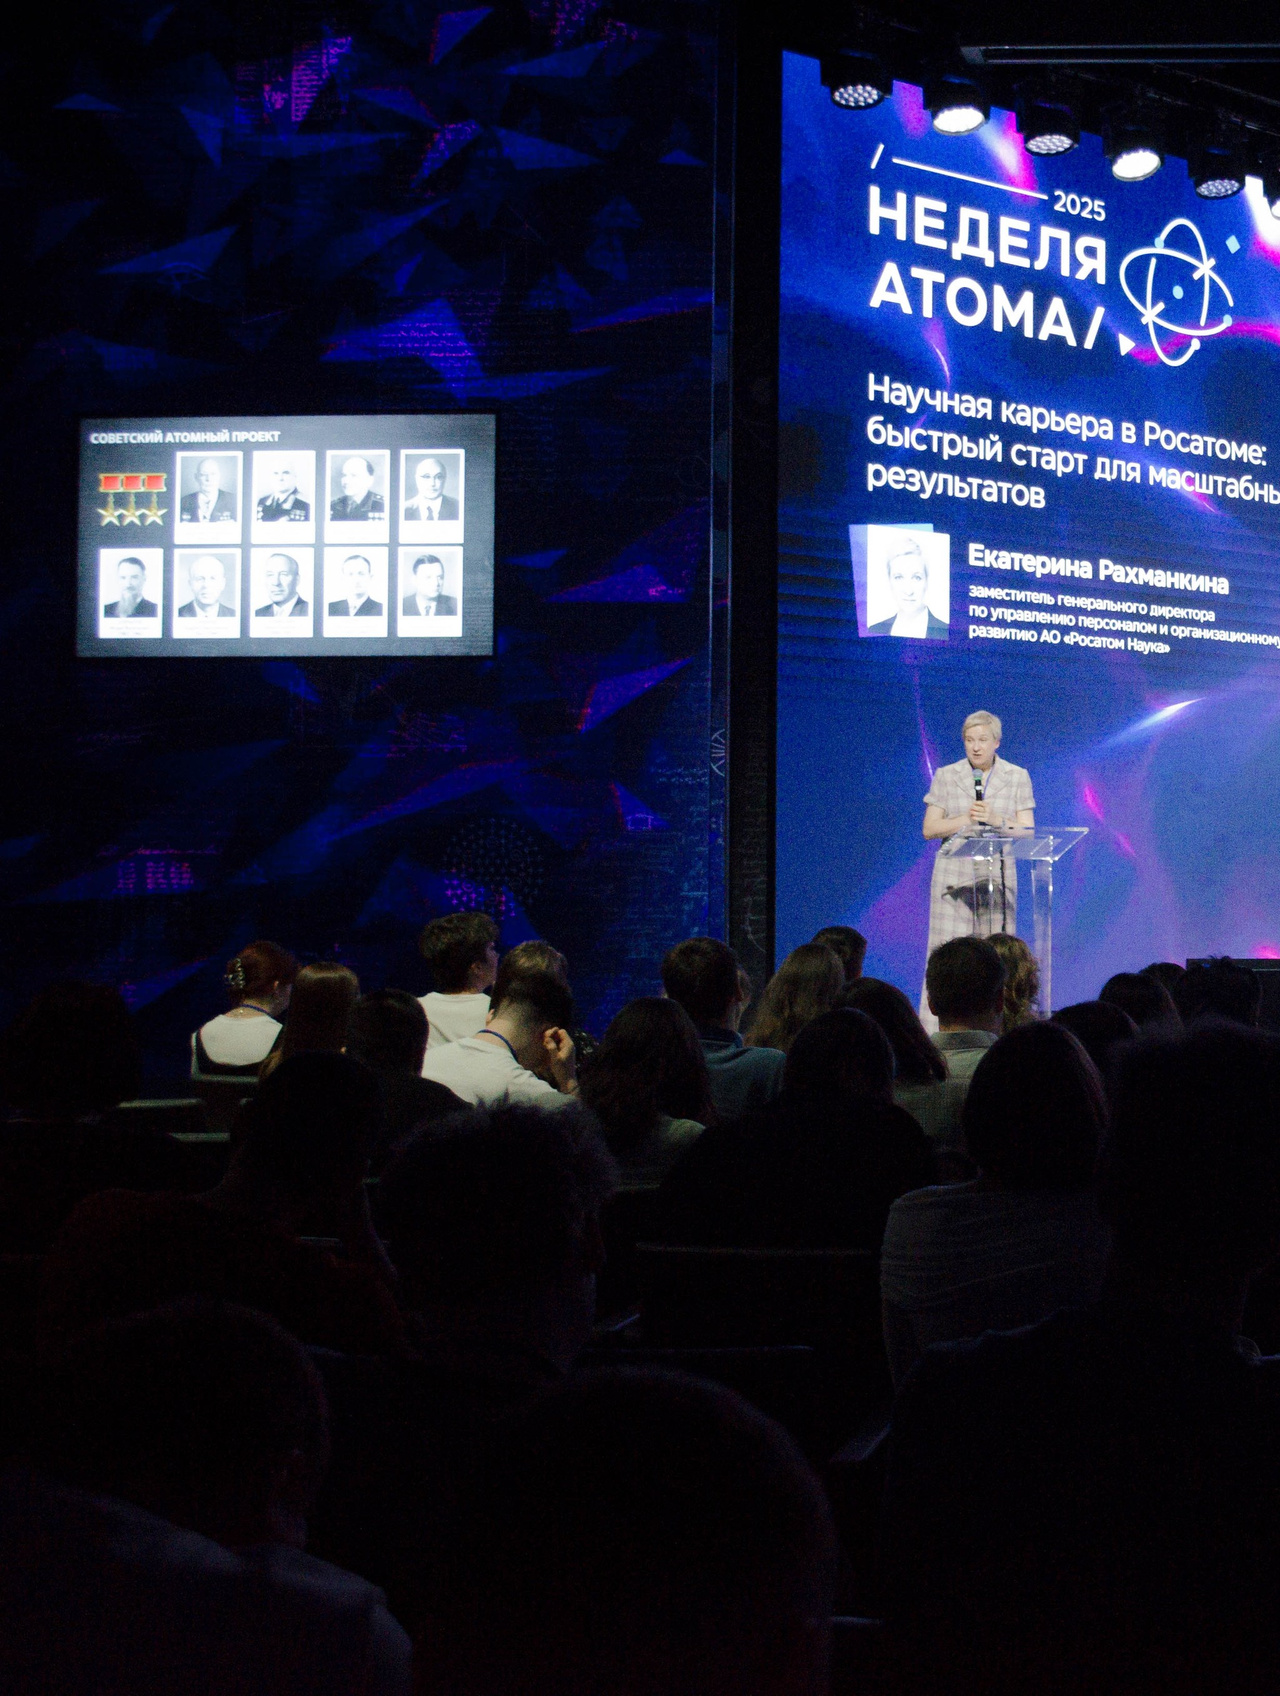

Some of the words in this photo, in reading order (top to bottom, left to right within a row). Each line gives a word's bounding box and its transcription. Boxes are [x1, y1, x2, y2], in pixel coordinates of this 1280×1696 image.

[1053, 189, 1107, 222] 2025
[868, 184, 1107, 286] НЕДЕЛЯ
[90, 430, 163, 444] СОВЕТСКИЙ
[164, 429, 230, 443] АТОМНЫЙ
[232, 431, 281, 443] ПРОЕКТ
[867, 372, 993, 421] Научная
[1001, 400, 1114, 442] карьера
[1120, 421, 1137, 444] в
[1144, 420, 1268, 466] Росатоме:
[866, 414, 1003, 463] быстрый
[1010, 443, 1089, 478] старт
[1094, 456, 1141, 484] для
[866, 462, 1047, 509] результатов
[968, 542, 1093, 579] Екатерина
[1099, 558, 1230, 595] Рахманкина
[968, 584, 1055, 605] заместитель
[1057, 594, 1148, 615] генерального
[1150, 604, 1216, 623] директора
[968, 604, 988, 618] по
[990, 606, 1076, 627] управлению
[1078, 615, 1157, 635] персоналом
[1159, 624, 1169, 636] и
[968, 624, 1038, 641] развитию
[1040, 628, 1061, 644] АО
[1063, 631, 1125, 650] «Росатом
[1127, 636, 1171, 655] Наука»
